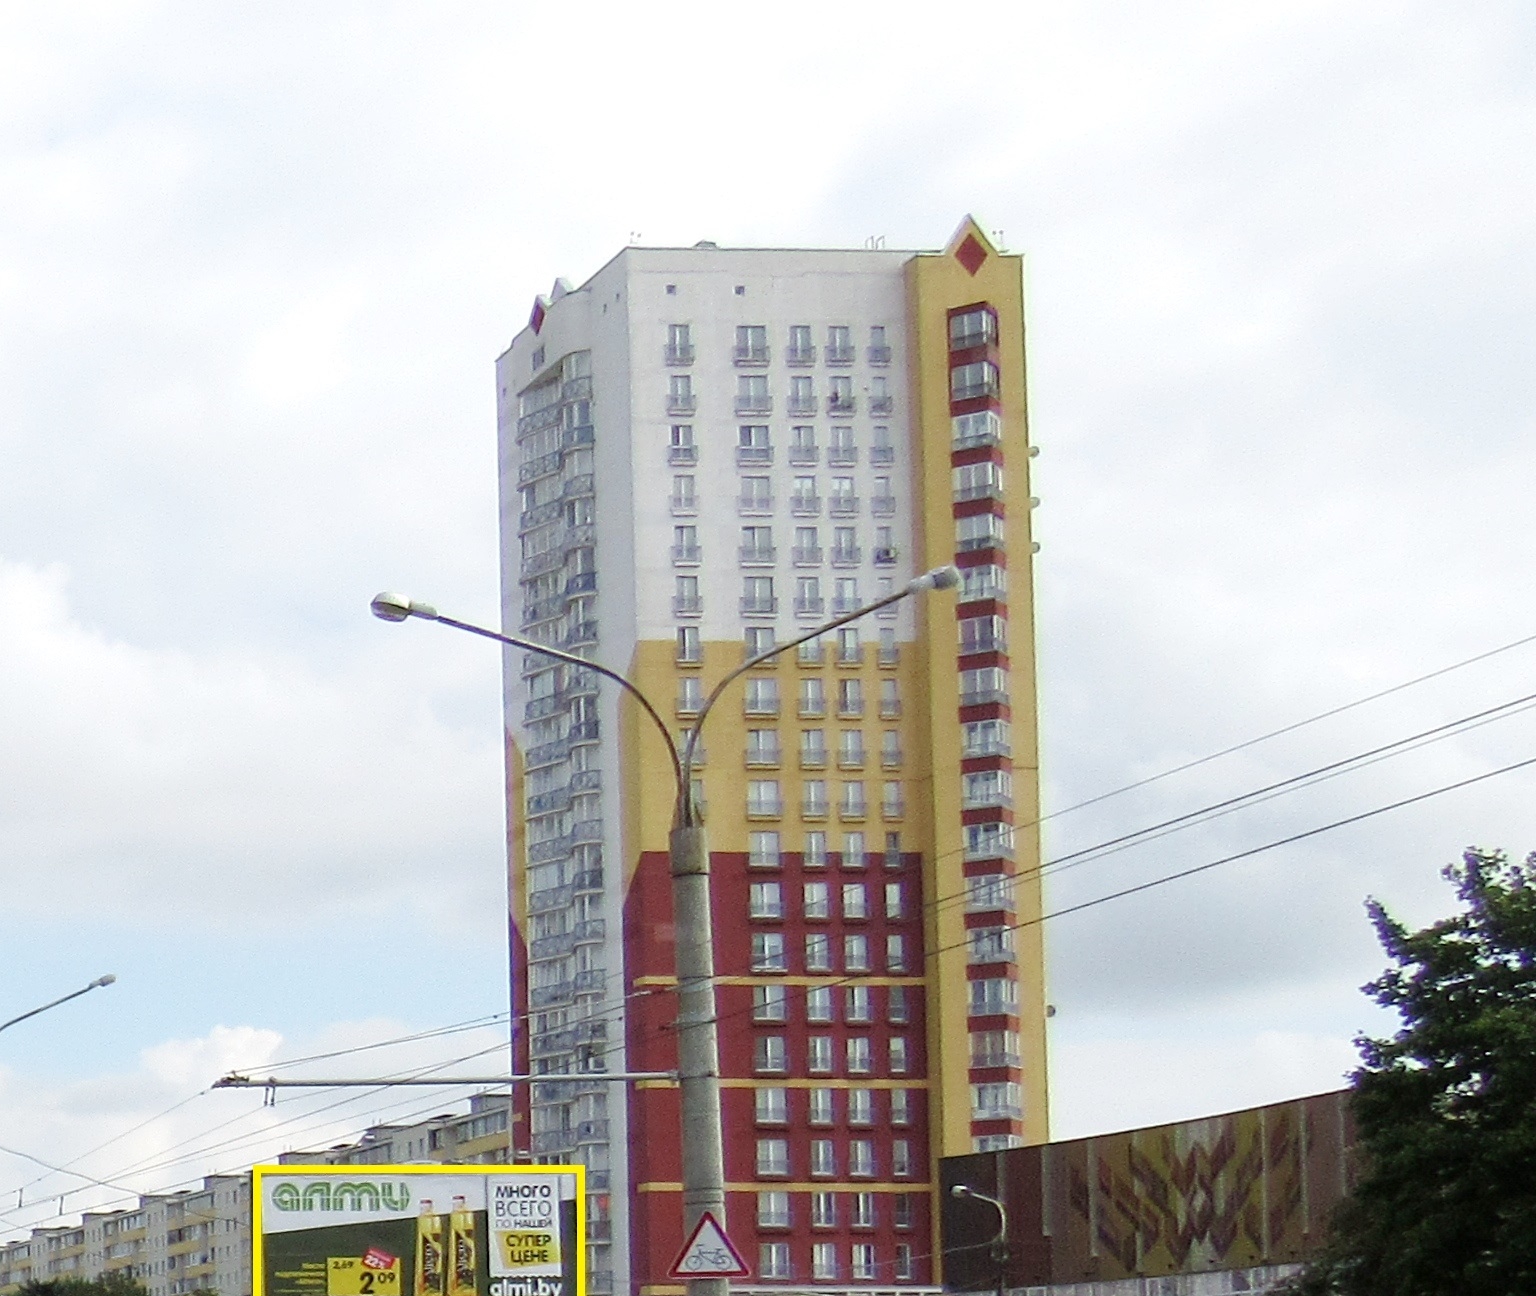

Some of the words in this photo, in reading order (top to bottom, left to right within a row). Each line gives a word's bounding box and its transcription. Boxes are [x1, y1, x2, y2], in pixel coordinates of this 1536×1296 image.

[495, 1185, 552, 1198] МНОГО
[495, 1200, 552, 1217] ВСЕГО
[495, 1219, 511, 1228] ПО
[513, 1217, 553, 1228] НАШЕЙ
[505, 1235, 552, 1247] СУПЕР
[510, 1250, 550, 1265] ЦЕНЕ
